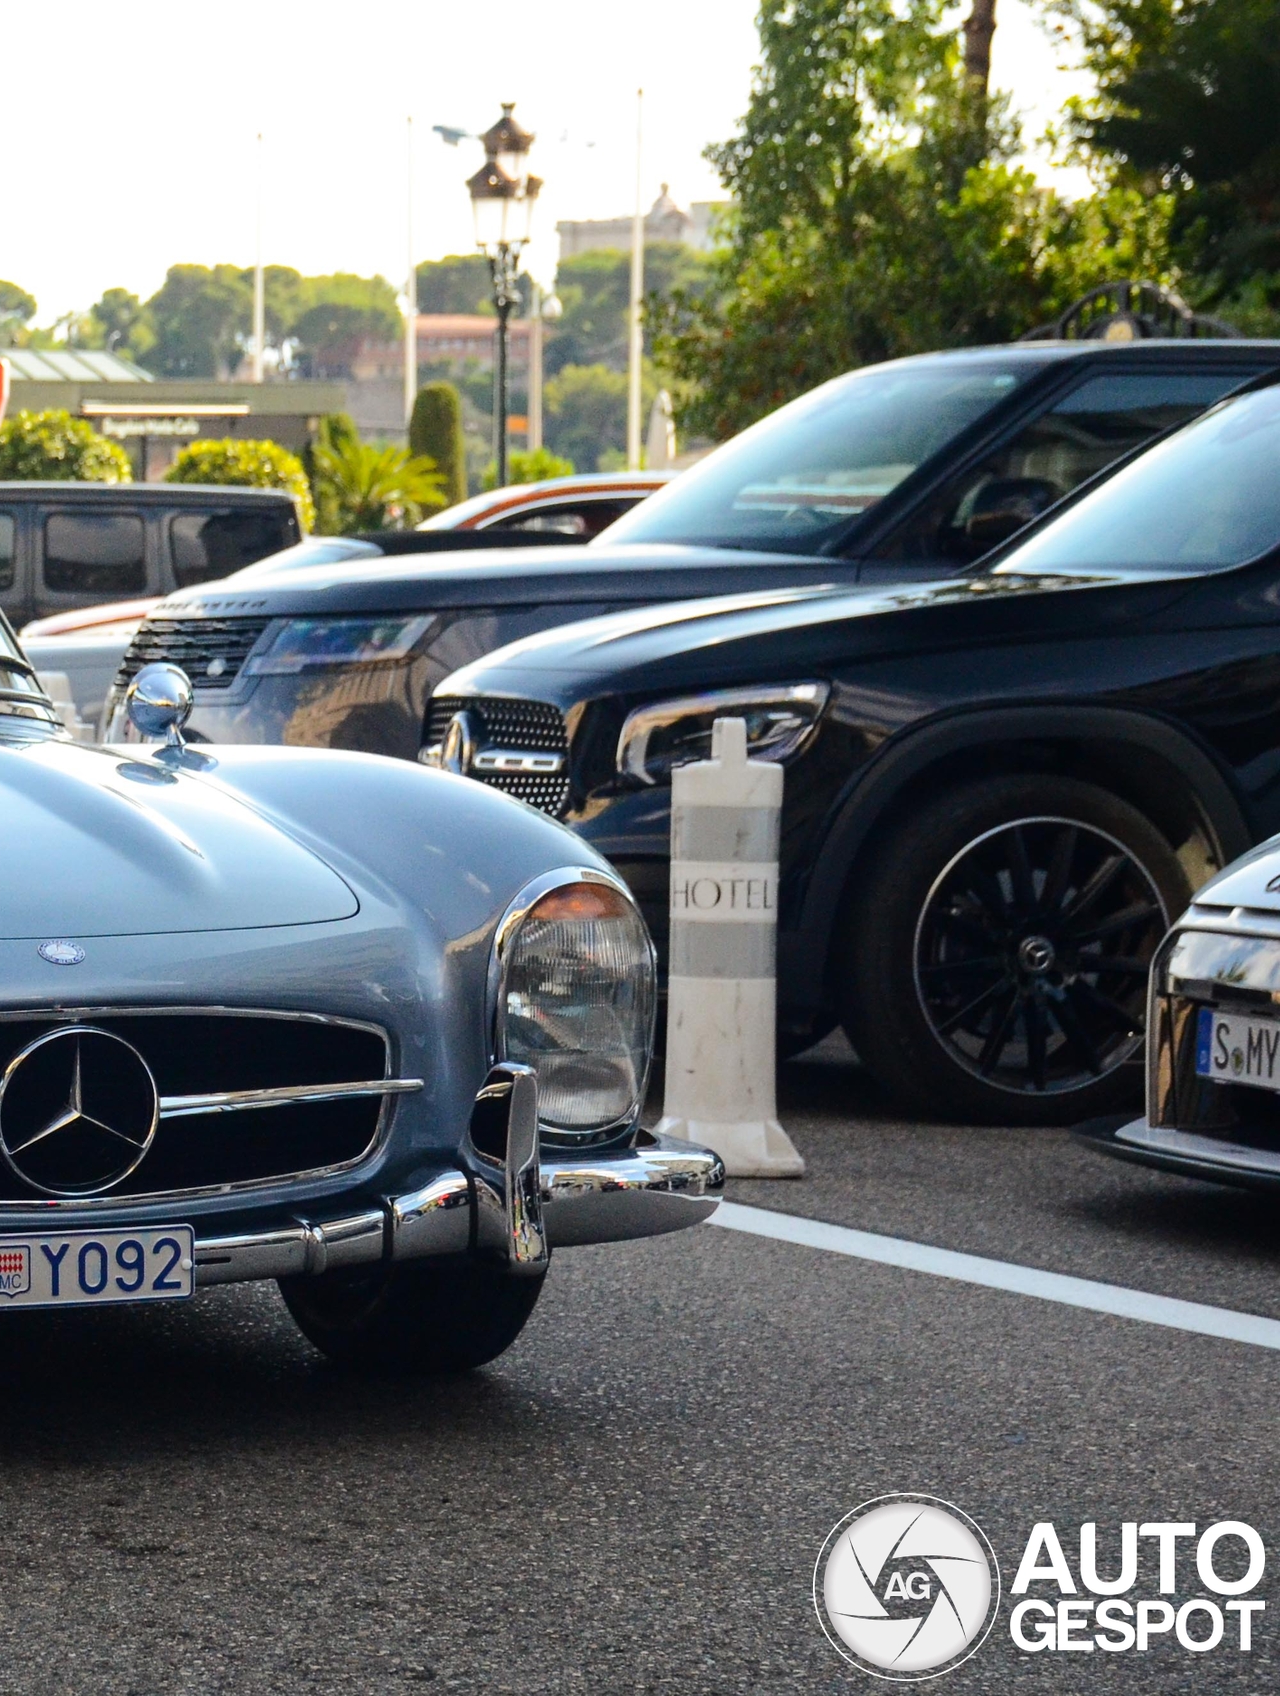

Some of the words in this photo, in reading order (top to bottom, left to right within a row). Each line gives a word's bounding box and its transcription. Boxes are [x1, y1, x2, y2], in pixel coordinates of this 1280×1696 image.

[673, 877, 772, 910] HOTEL
[1214, 1022, 1230, 1071] S
[1246, 1026, 1280, 1079] MY
[40, 1236, 182, 1297] Y092
